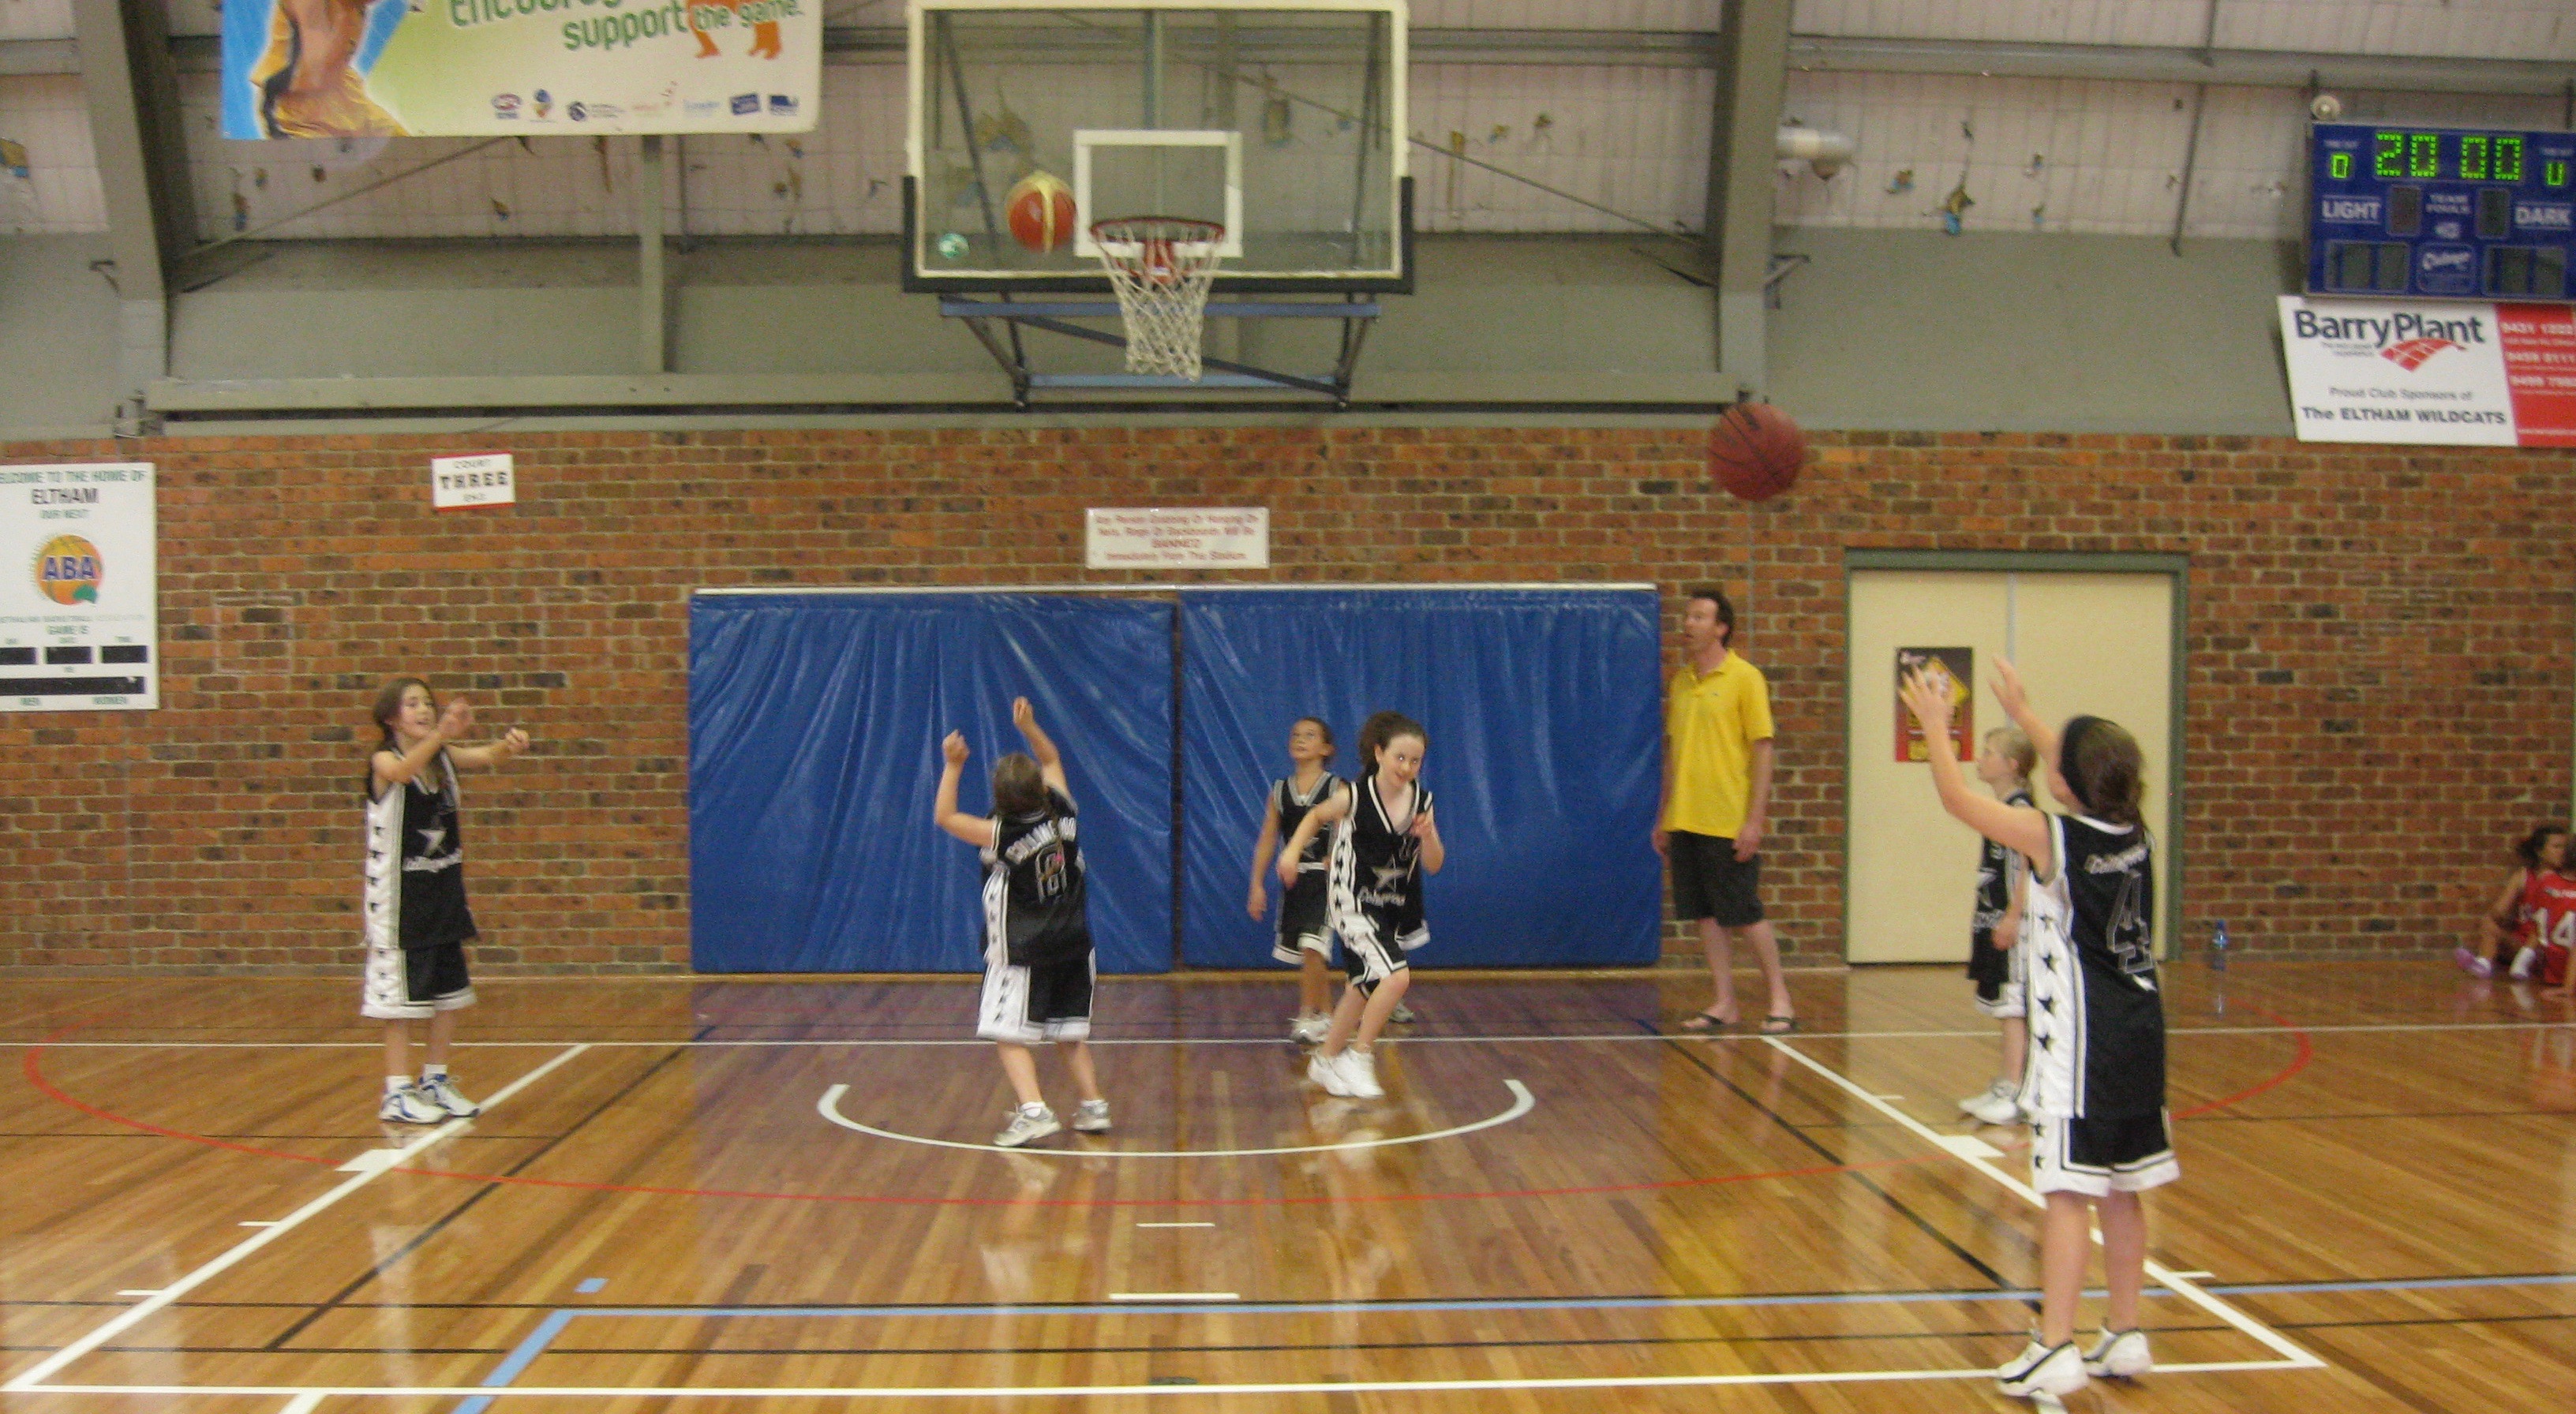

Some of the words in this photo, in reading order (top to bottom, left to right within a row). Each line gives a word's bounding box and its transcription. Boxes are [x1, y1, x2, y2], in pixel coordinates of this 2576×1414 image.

[563, 0, 688, 50] support
[2376, 132, 2437, 178] 20
[2322, 200, 2381, 219] LIGHT
[2514, 207, 2572, 226] DARK
[2301, 406, 2334, 420] The
[2340, 407, 2411, 423] ELTHAM
[2416, 410, 2507, 425] WILDCATS
[0, 472, 43, 484] ELCOME
[65, 470, 90, 482] THE
[92, 469, 127, 482] HOME
[440, 471, 507, 490] THREE
[32, 487, 99, 504] ELTHAM
[44, 556, 95, 581] ABA
[2531, 907, 2576, 948] 14
